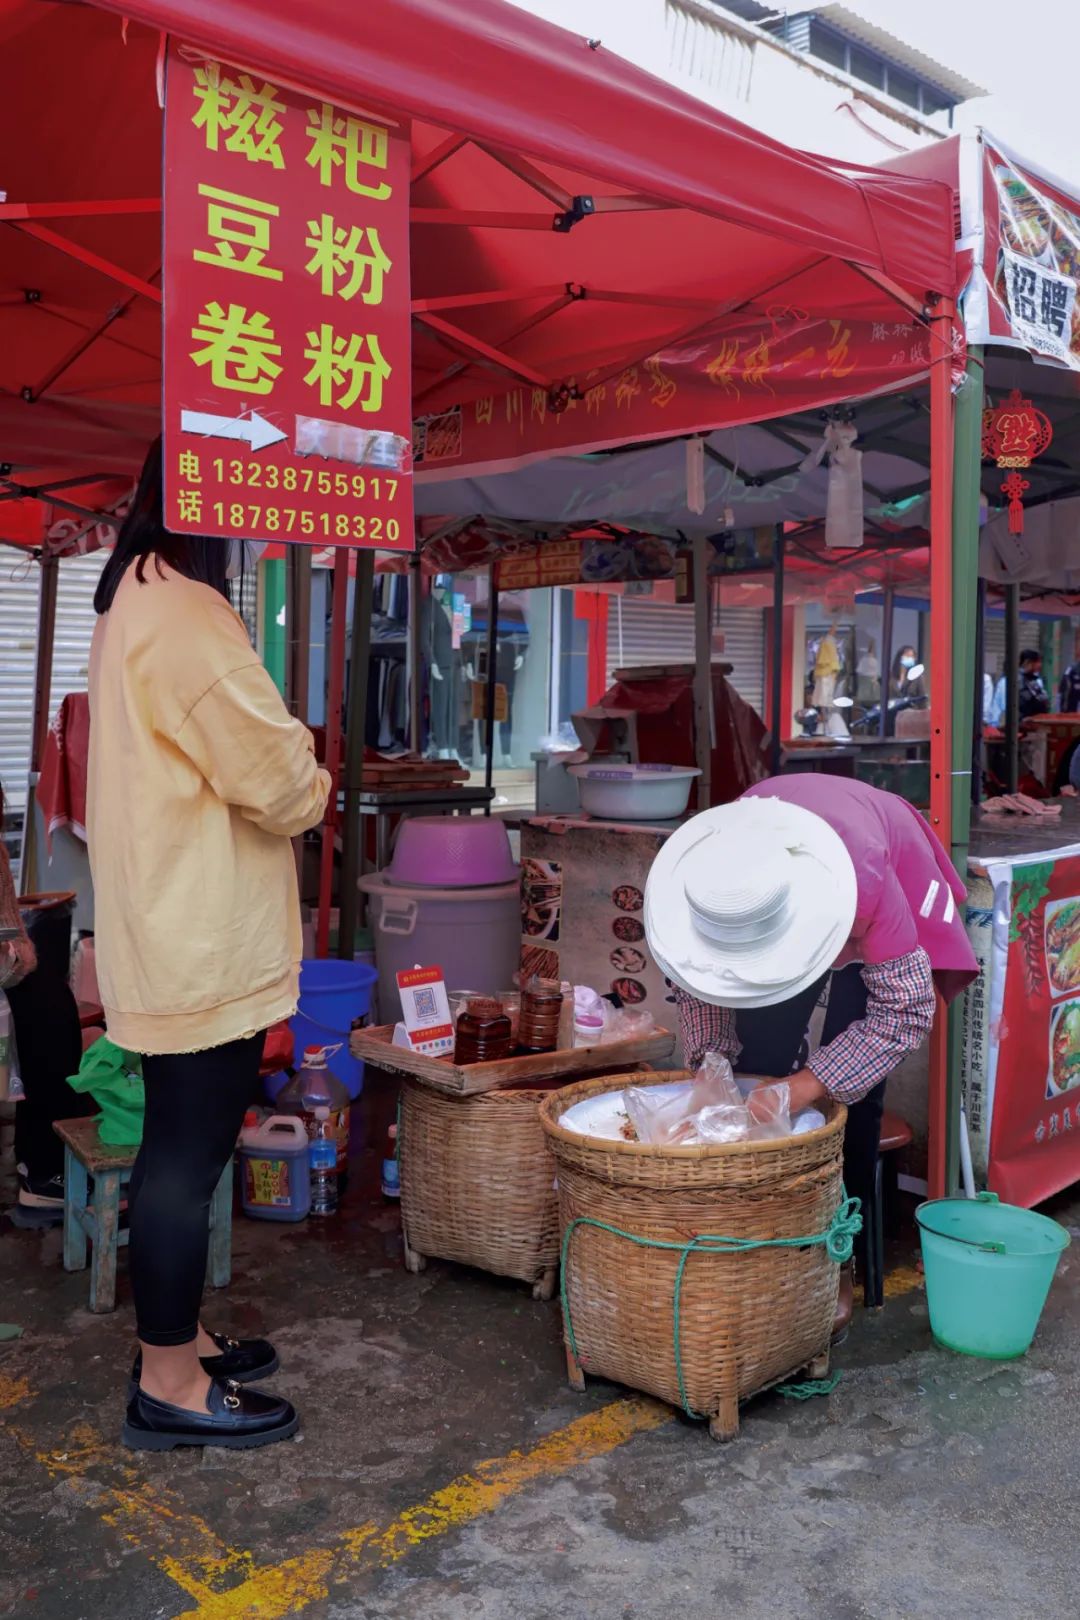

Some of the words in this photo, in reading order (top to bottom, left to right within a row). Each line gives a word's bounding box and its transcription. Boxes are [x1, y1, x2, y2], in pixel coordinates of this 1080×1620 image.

[191, 67, 391, 200] 糍粑
[193, 182, 392, 304] 豆粉
[1012, 263, 1068, 338] 招聘
[189, 301, 392, 412] 卷粉
[177, 450, 203, 524] 电话
[213, 459, 398, 502] 13238755917
[213, 502, 400, 541] 18787518320
